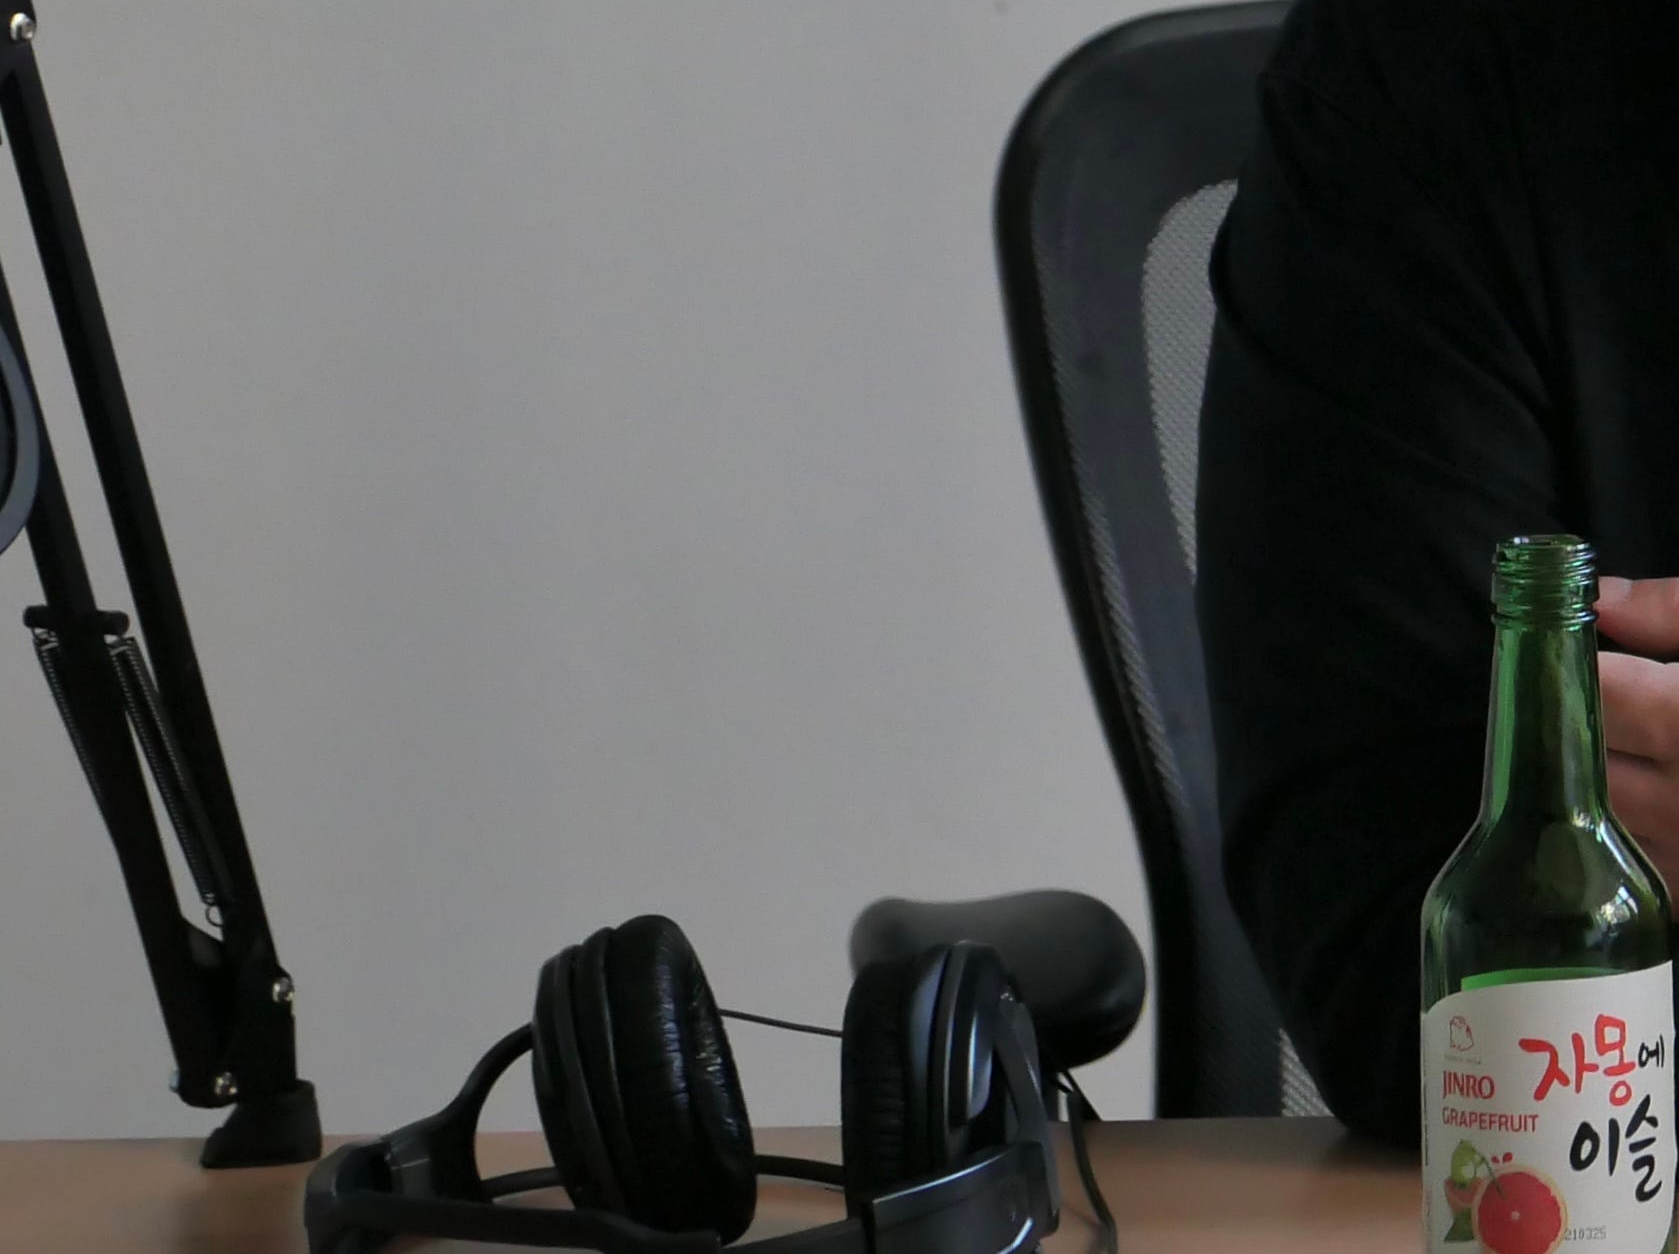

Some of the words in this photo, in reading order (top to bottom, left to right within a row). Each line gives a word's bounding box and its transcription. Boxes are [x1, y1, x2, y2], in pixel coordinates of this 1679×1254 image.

[1442, 1069, 1496, 1100] JINRO
[1442, 1107, 1539, 1133] GRAPEFRUIT
[1569, 1094, 1663, 1202] 이슬
